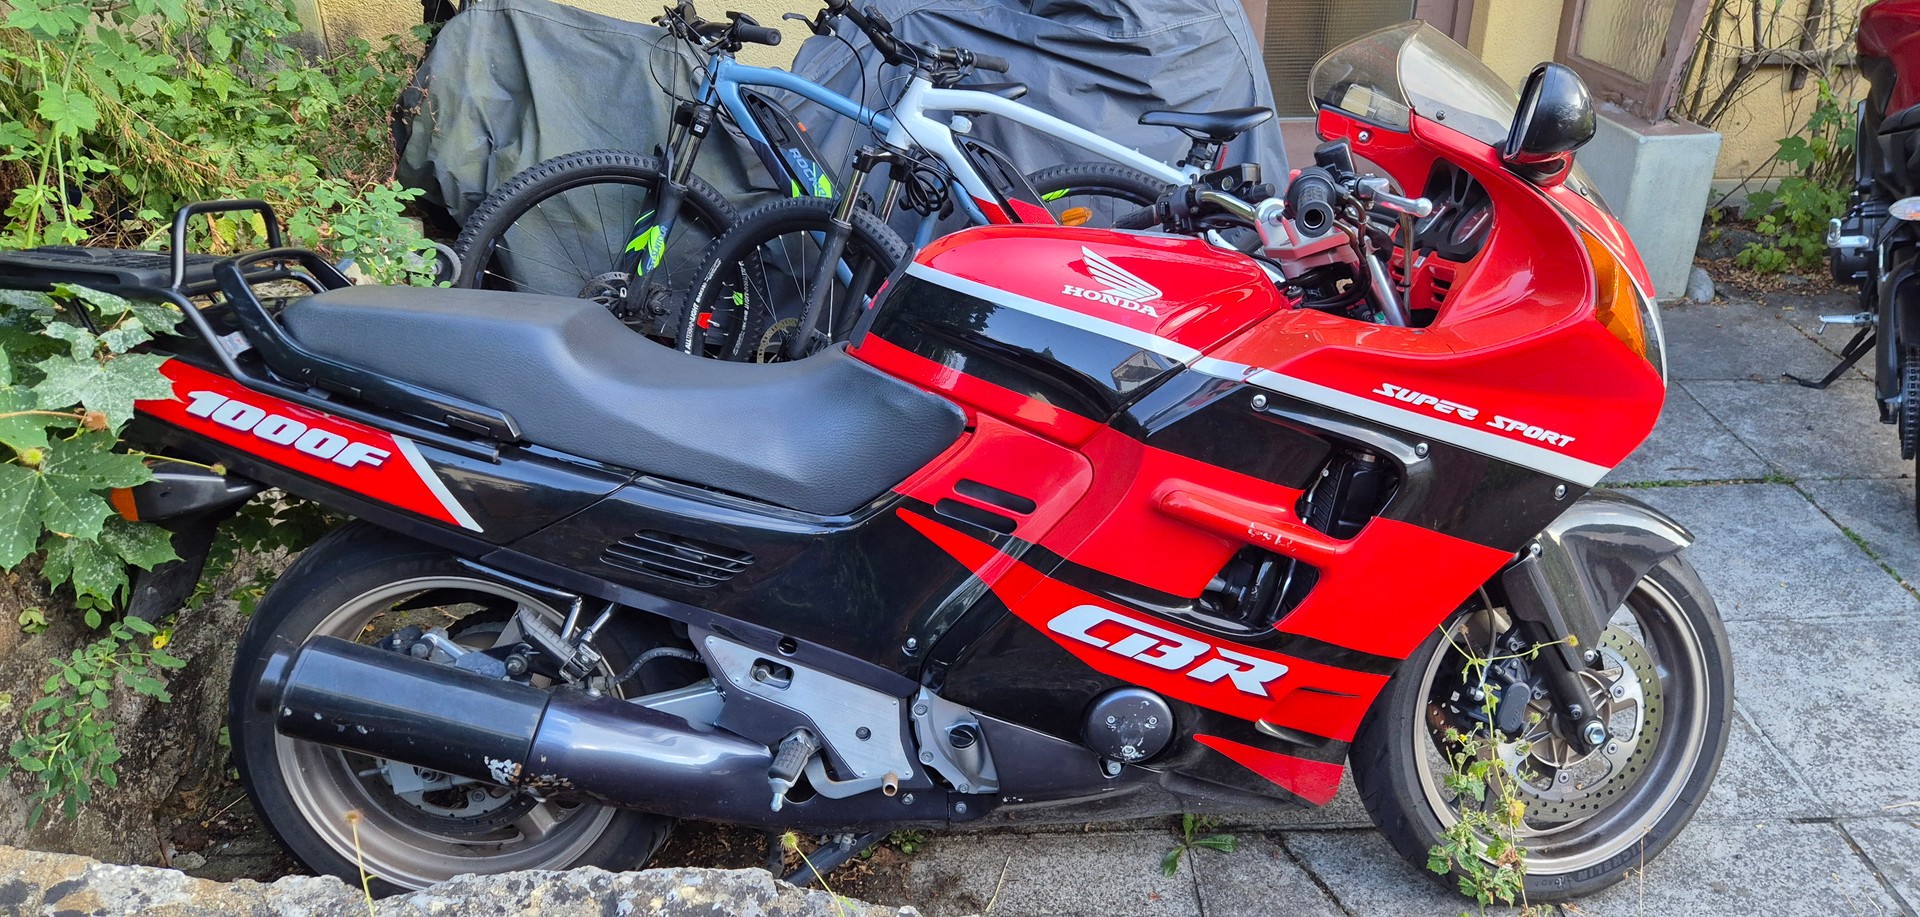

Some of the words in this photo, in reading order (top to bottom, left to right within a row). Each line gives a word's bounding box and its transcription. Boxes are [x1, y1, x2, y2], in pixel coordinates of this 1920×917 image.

[1061, 284, 1159, 318] HONDA
[185, 390, 392, 468] 1000F
[1371, 382, 1480, 421] SUPER
[1485, 414, 1576, 448] SPORT
[1047, 604, 1289, 697] CBR
